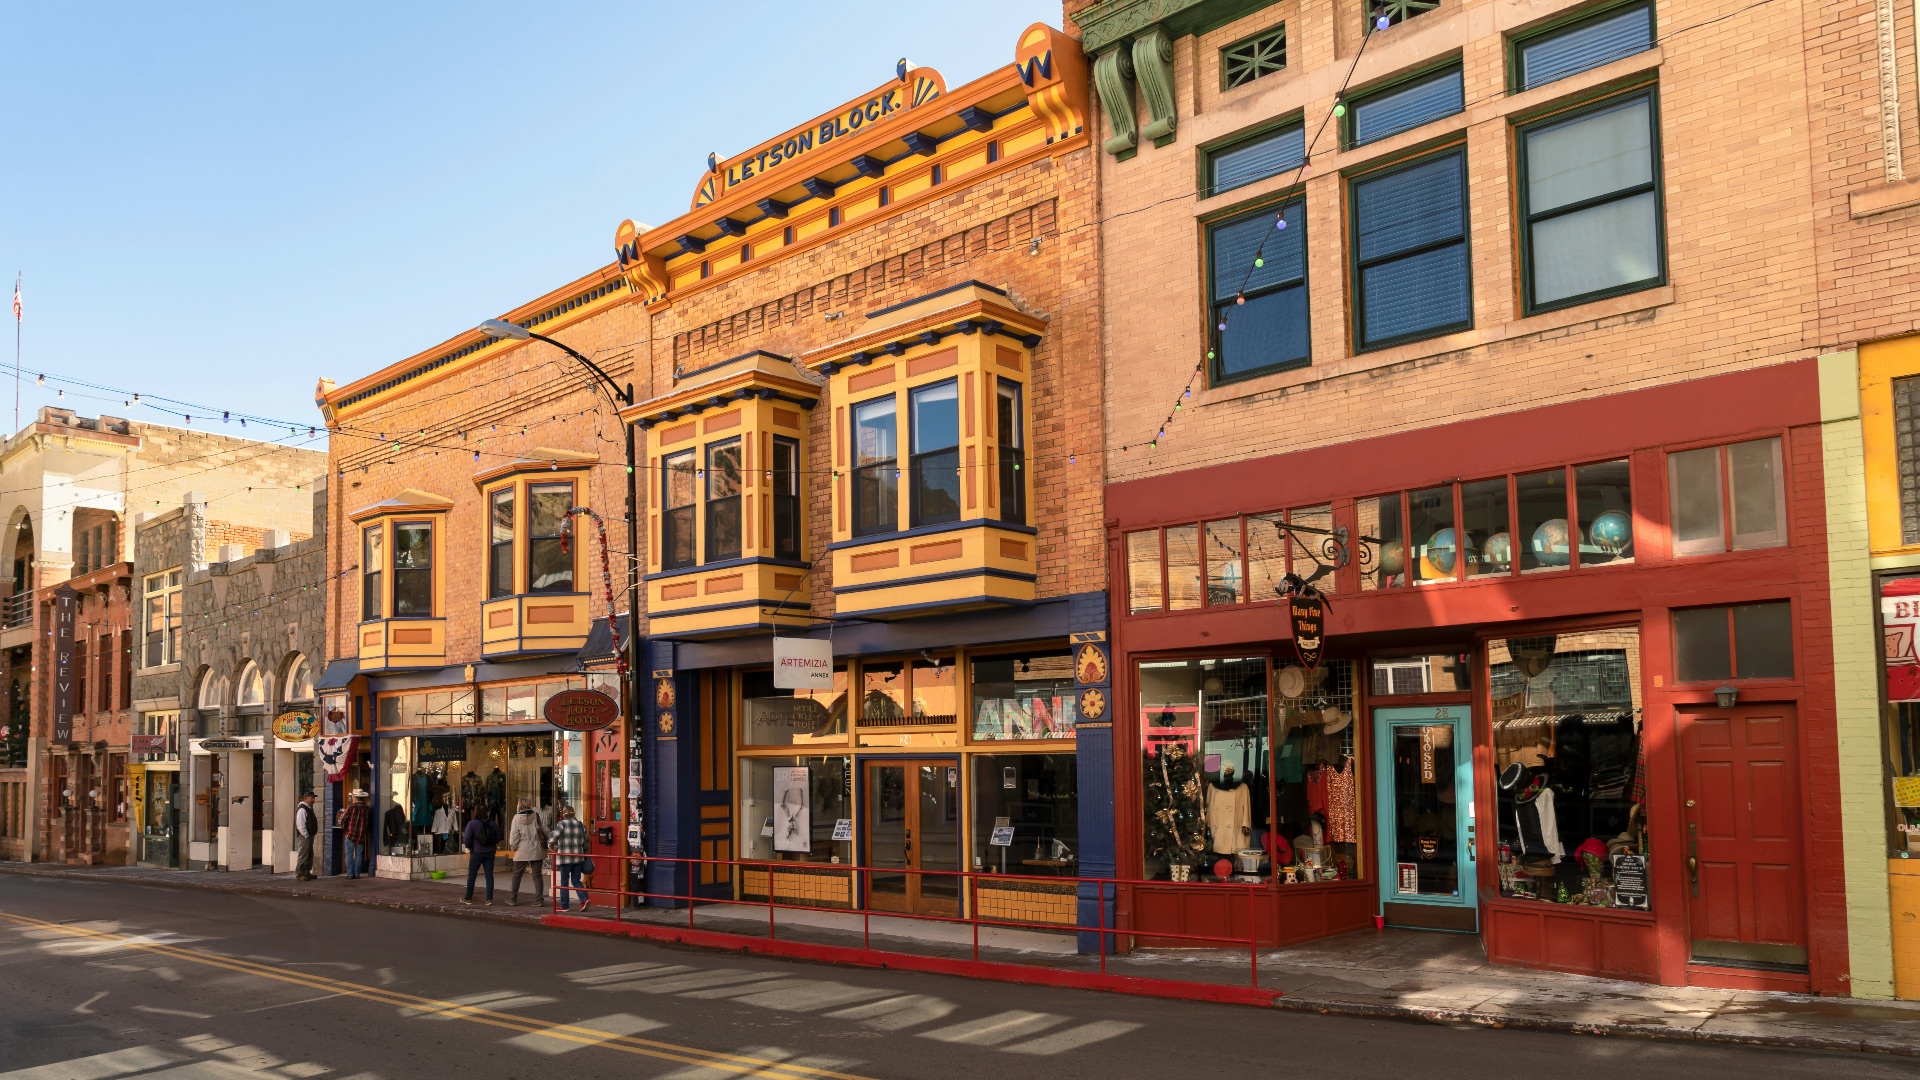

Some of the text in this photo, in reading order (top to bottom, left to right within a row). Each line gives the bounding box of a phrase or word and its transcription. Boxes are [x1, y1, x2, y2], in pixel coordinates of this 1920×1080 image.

[728, 90, 901, 187] LETSON BLOCK.
[1292, 605, 1321, 618] Many Fine
[1298, 620, 1317, 633] Things
[57, 597, 71, 739] THE REVIEW
[780, 658, 828, 668] ARTEMIZIA
[561, 695, 605, 707] LETSON
[567, 705, 596, 716] LOFT
[1435, 707, 1449, 719] 28
[563, 715, 603, 726] HOTEL
[280, 724, 303, 734] Honey
